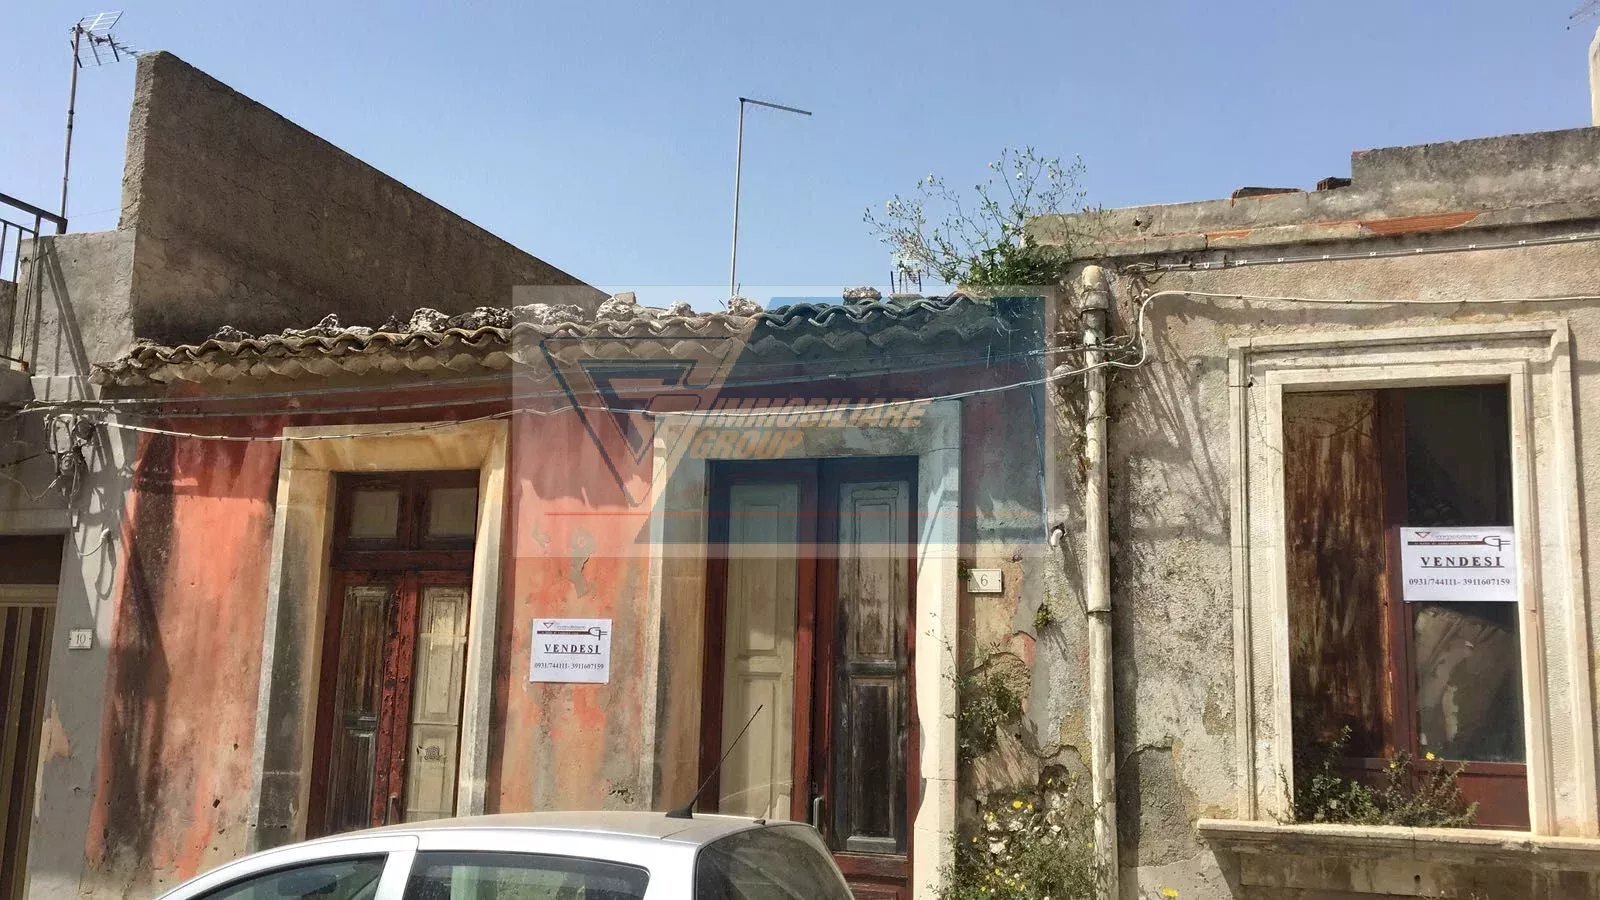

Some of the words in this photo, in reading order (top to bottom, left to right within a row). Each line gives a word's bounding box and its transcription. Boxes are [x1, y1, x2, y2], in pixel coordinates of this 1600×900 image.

[1420, 556, 1502, 567] VENDESI
[980, 573, 989, 587] 6
[1463, 578, 1511, 586] 3911607159
[76, 632, 87, 645] 10
[544, 643, 600, 654] VENDESI
